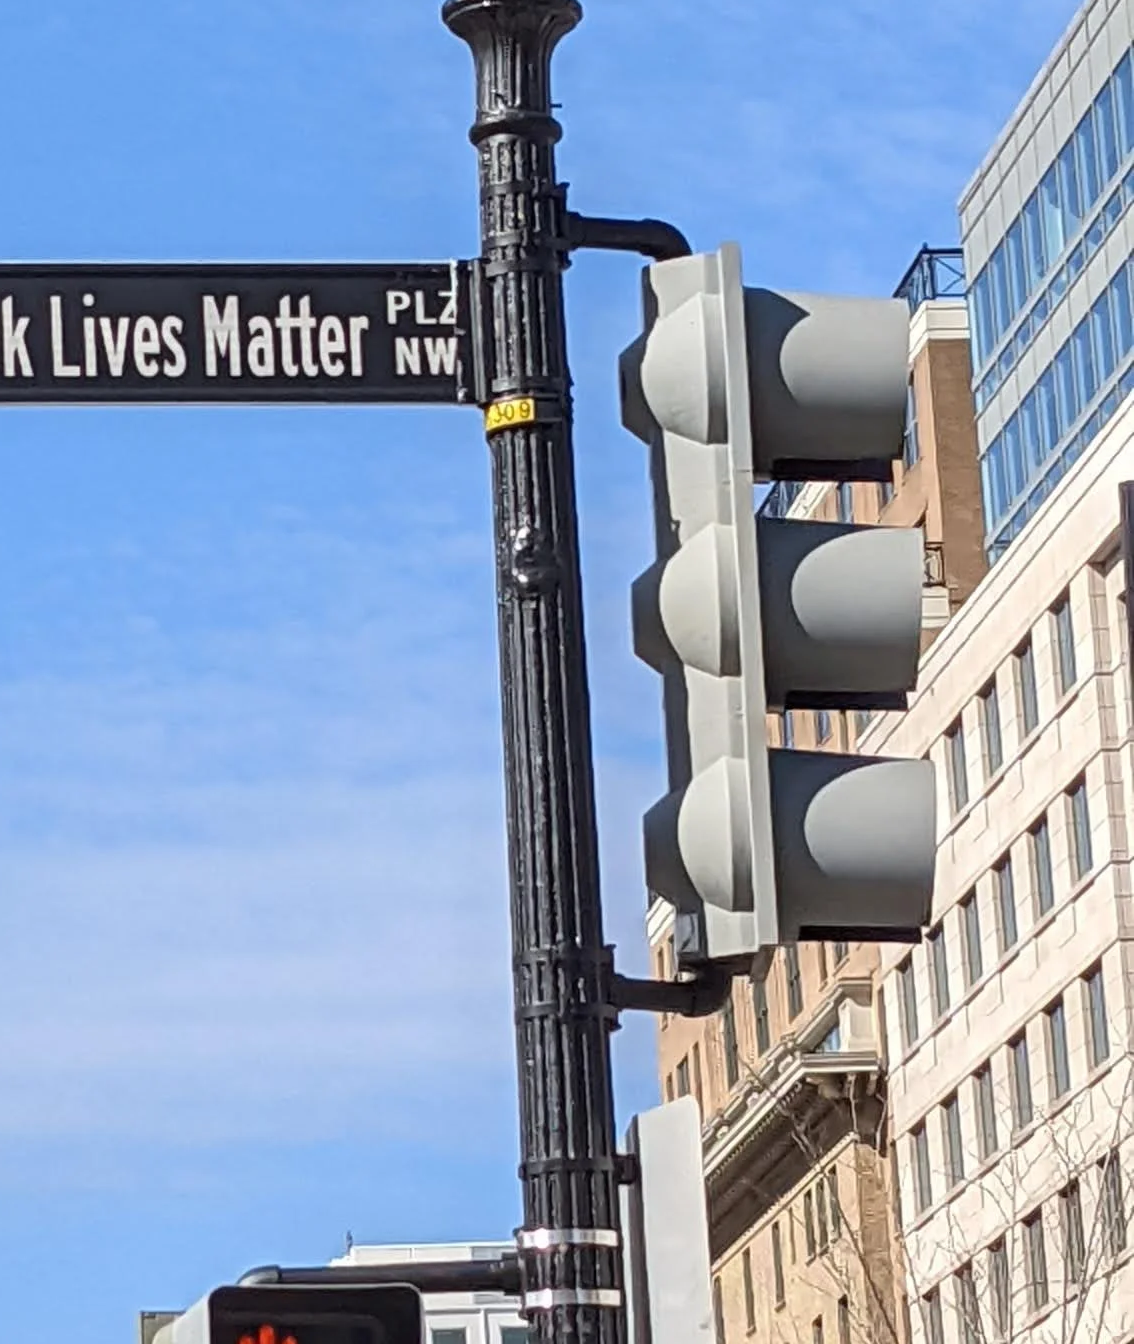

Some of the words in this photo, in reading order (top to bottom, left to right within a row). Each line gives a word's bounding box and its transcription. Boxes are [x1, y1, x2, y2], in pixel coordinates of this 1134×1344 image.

[386, 290, 458, 325] PLZ
[50, 293, 187, 378] Lives
[202, 294, 369, 377] Matter
[395, 337, 458, 376] NW
